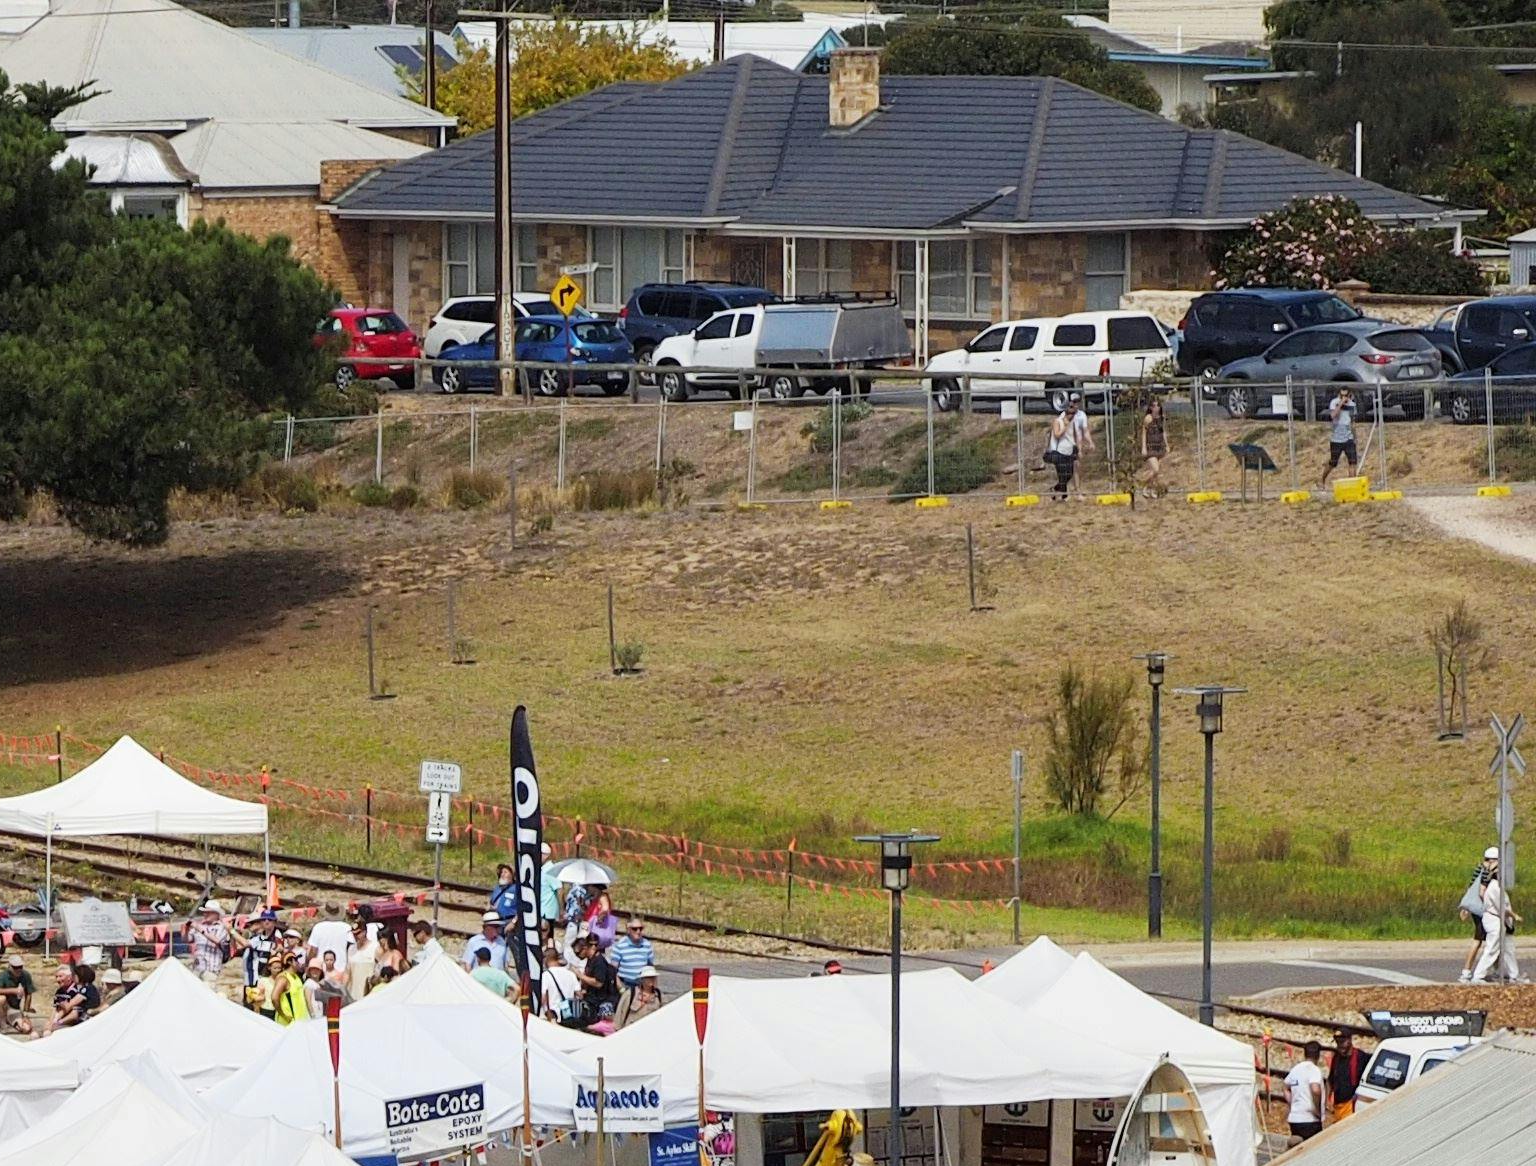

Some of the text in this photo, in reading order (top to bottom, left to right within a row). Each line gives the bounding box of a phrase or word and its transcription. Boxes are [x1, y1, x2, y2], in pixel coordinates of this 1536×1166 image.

[576, 1083, 659, 1110] Aqacote
[388, 1090, 481, 1125] Bote-Cote
[452, 1113, 482, 1128] EPOXY
[447, 1126, 483, 1142] SYSTEM
